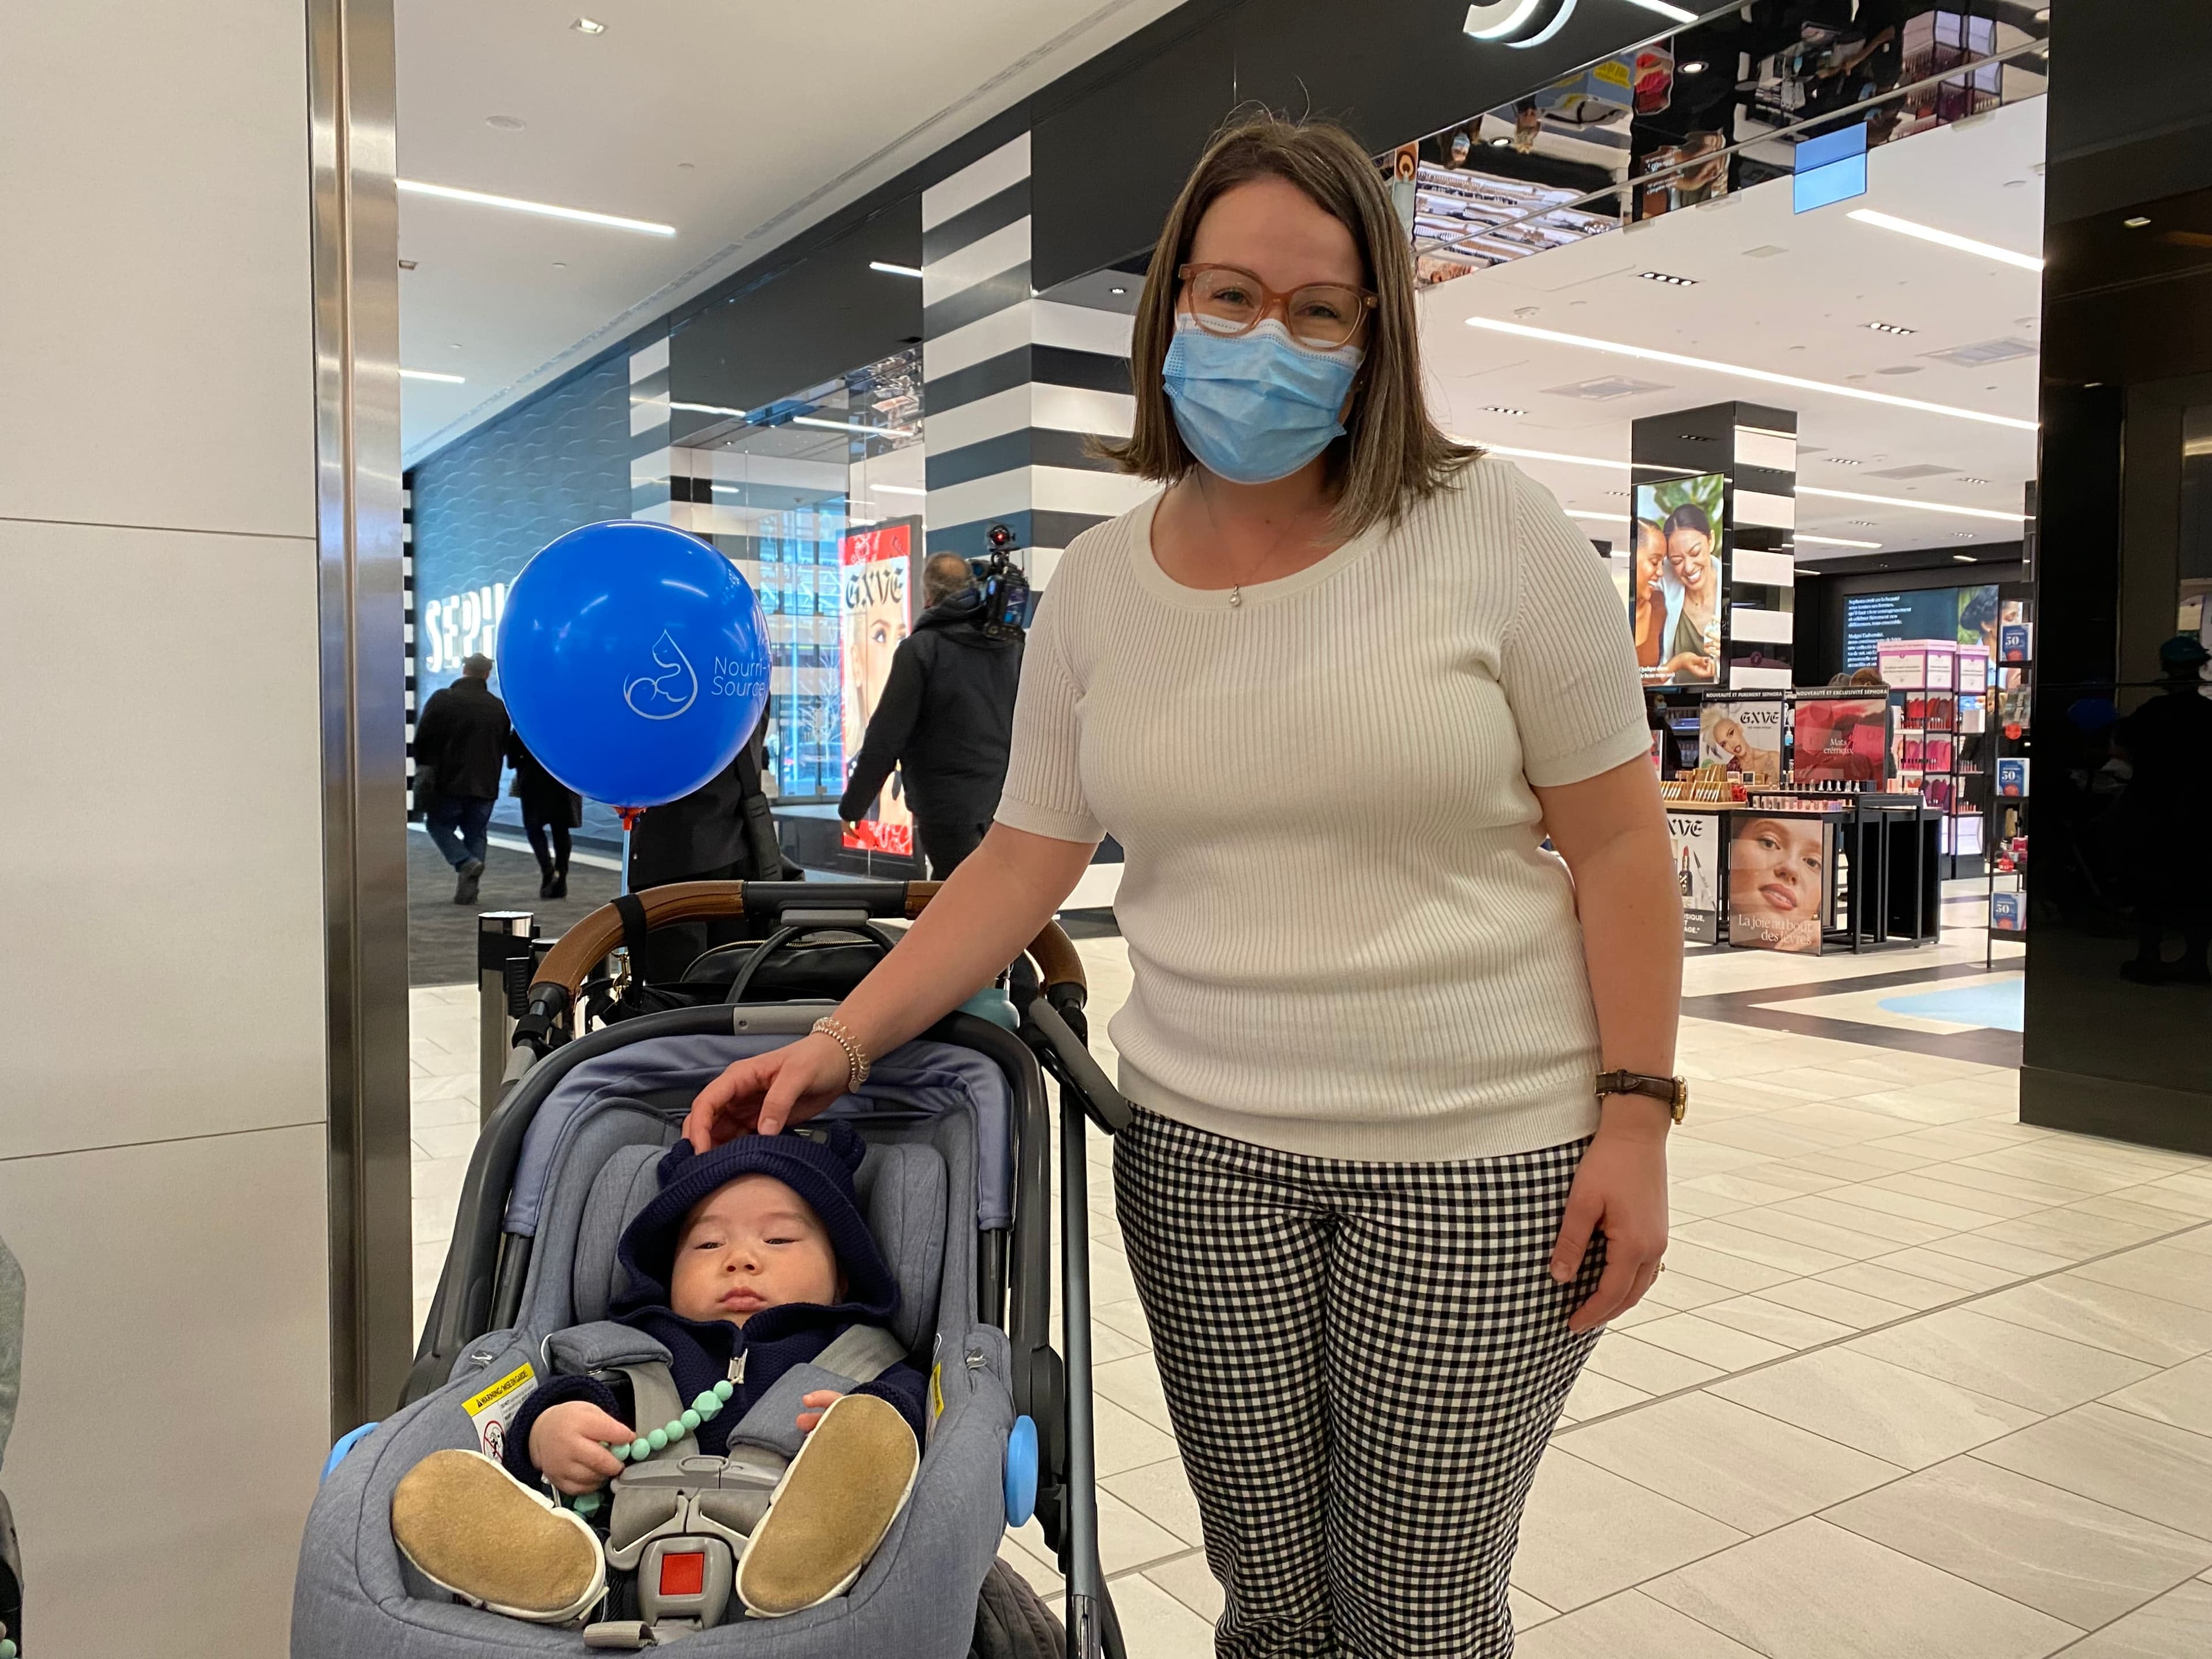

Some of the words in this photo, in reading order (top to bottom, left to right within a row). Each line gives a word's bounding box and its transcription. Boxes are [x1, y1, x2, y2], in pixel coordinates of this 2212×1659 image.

[846, 567, 903, 609] GXVE
[425, 583, 505, 673] SEPH
[714, 656, 766, 676] Nourri-
[711, 676, 766, 696] Source
[1740, 711, 1779, 724] GXVE
[1824, 747, 1854, 755] crémeux
[1830, 738, 1847, 747] Mats
[1668, 819, 1703, 837] XVE
[1738, 914, 1751, 926] La
[1751, 915, 1771, 930] joie
[1772, 920, 1785, 929] au
[1787, 919, 1812, 932] bout
[1761, 930, 1778, 942] des
[1781, 931, 1812, 945] lèvres
